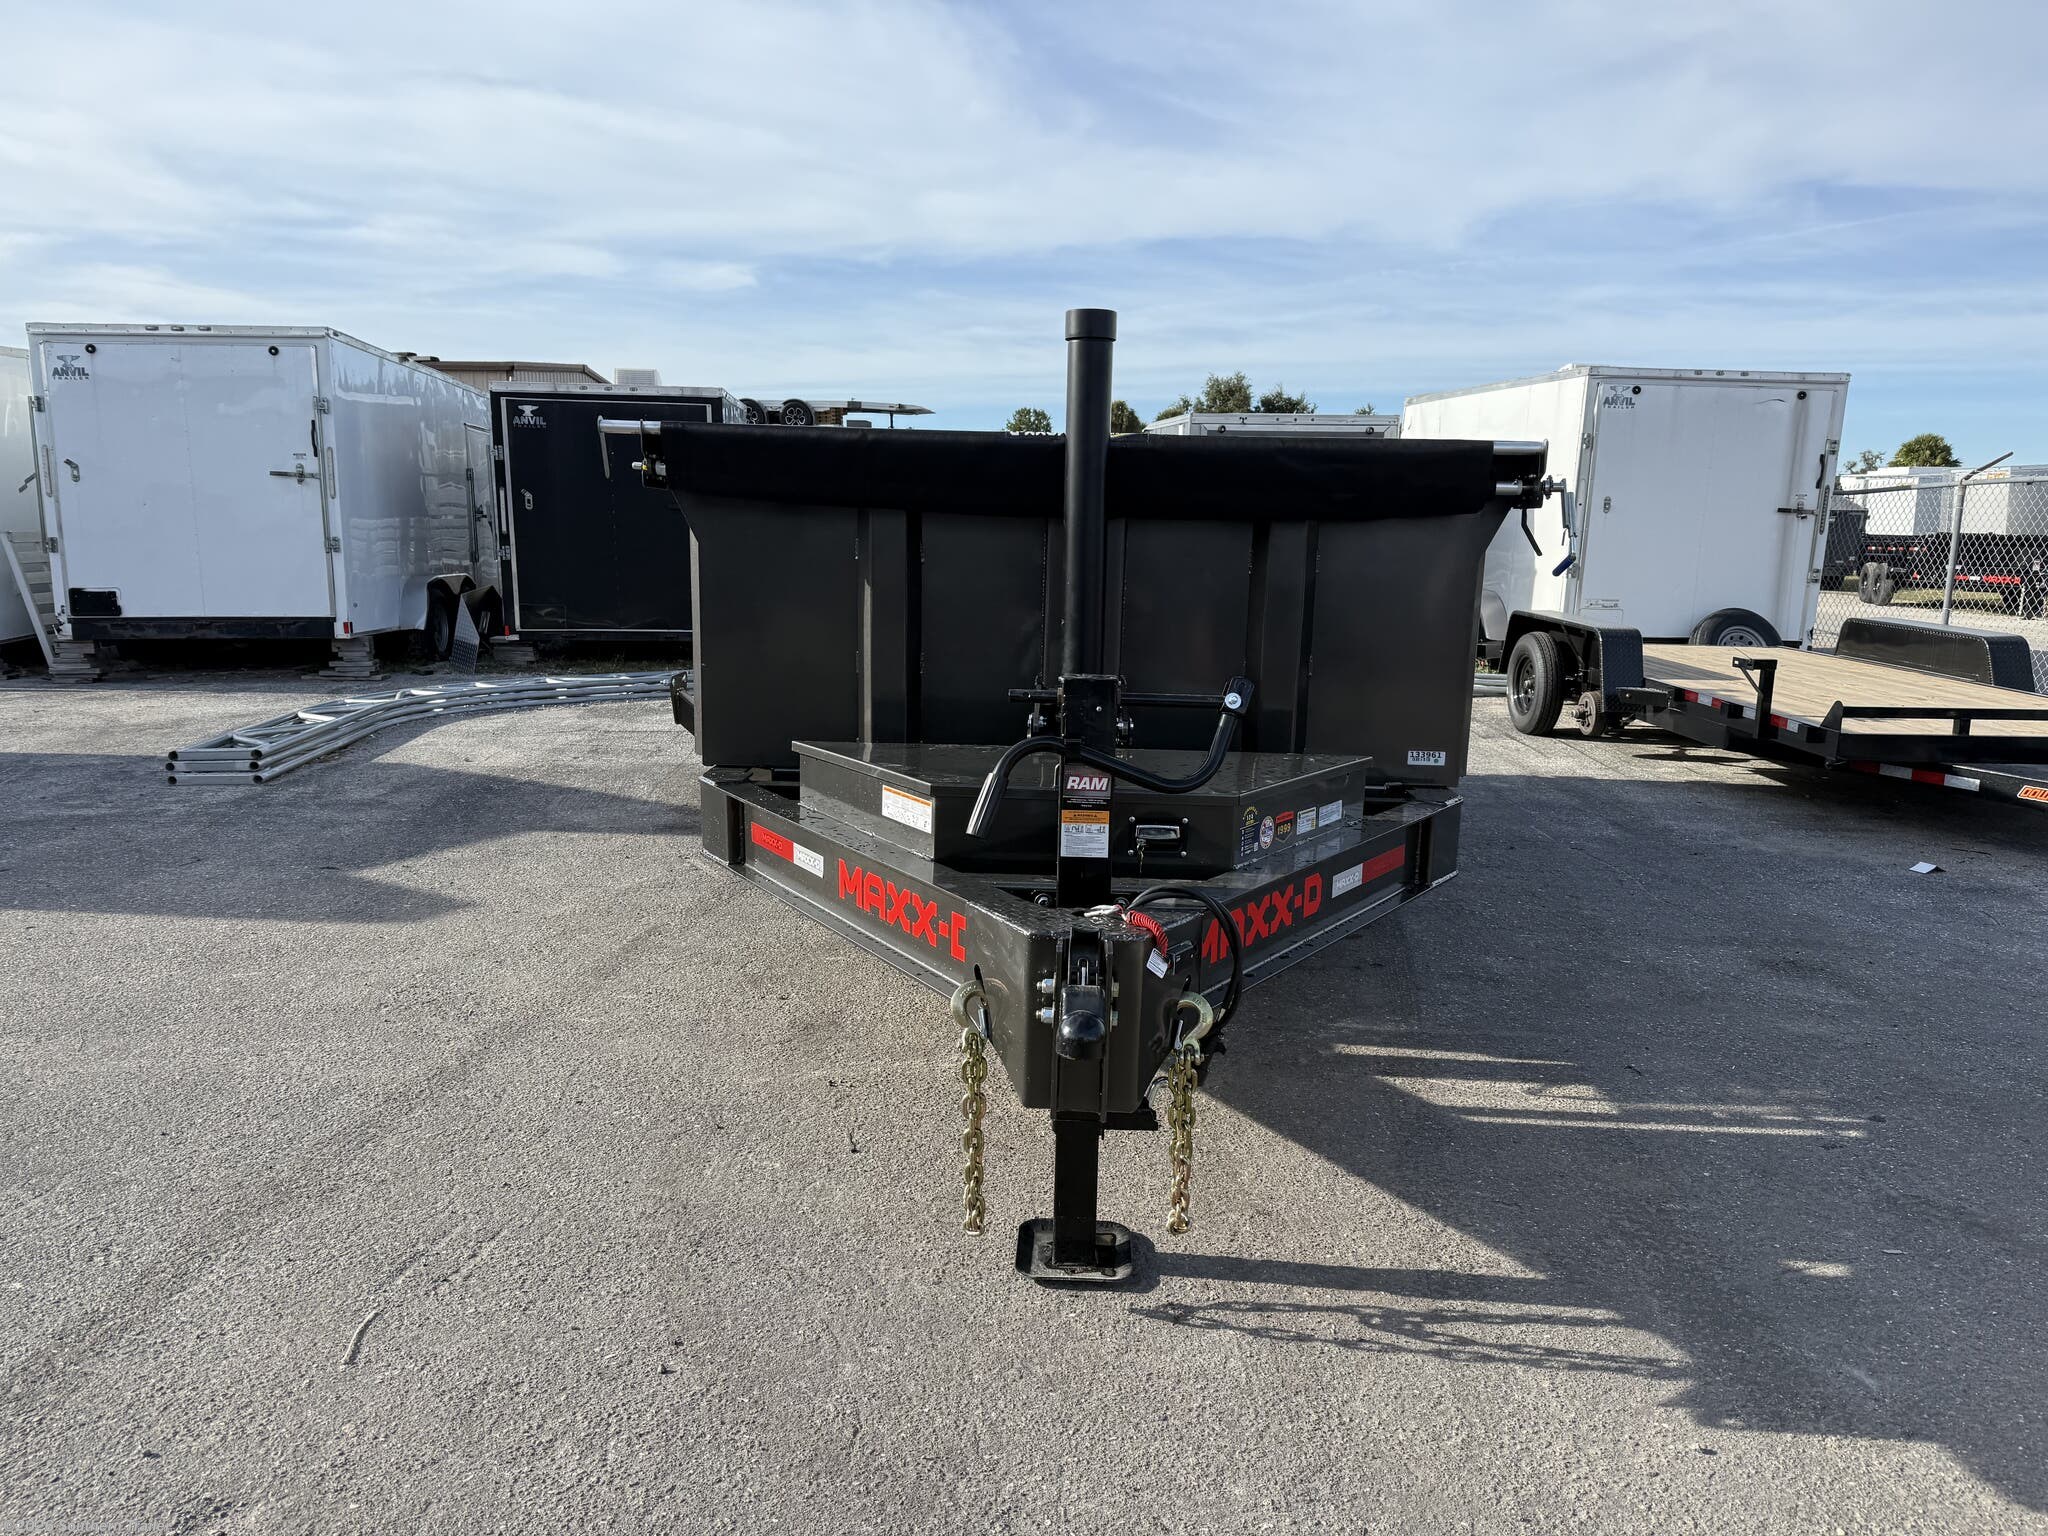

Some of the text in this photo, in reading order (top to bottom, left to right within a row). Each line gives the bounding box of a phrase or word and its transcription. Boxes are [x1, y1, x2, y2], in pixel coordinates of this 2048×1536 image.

[52, 367, 89, 376] ANVIL
[1603, 397, 1635, 405] ANVIL
[513, 416, 546, 424] ANVIL
[1410, 751, 1442, 759] 133961
[1066, 776, 1109, 791] RAM
